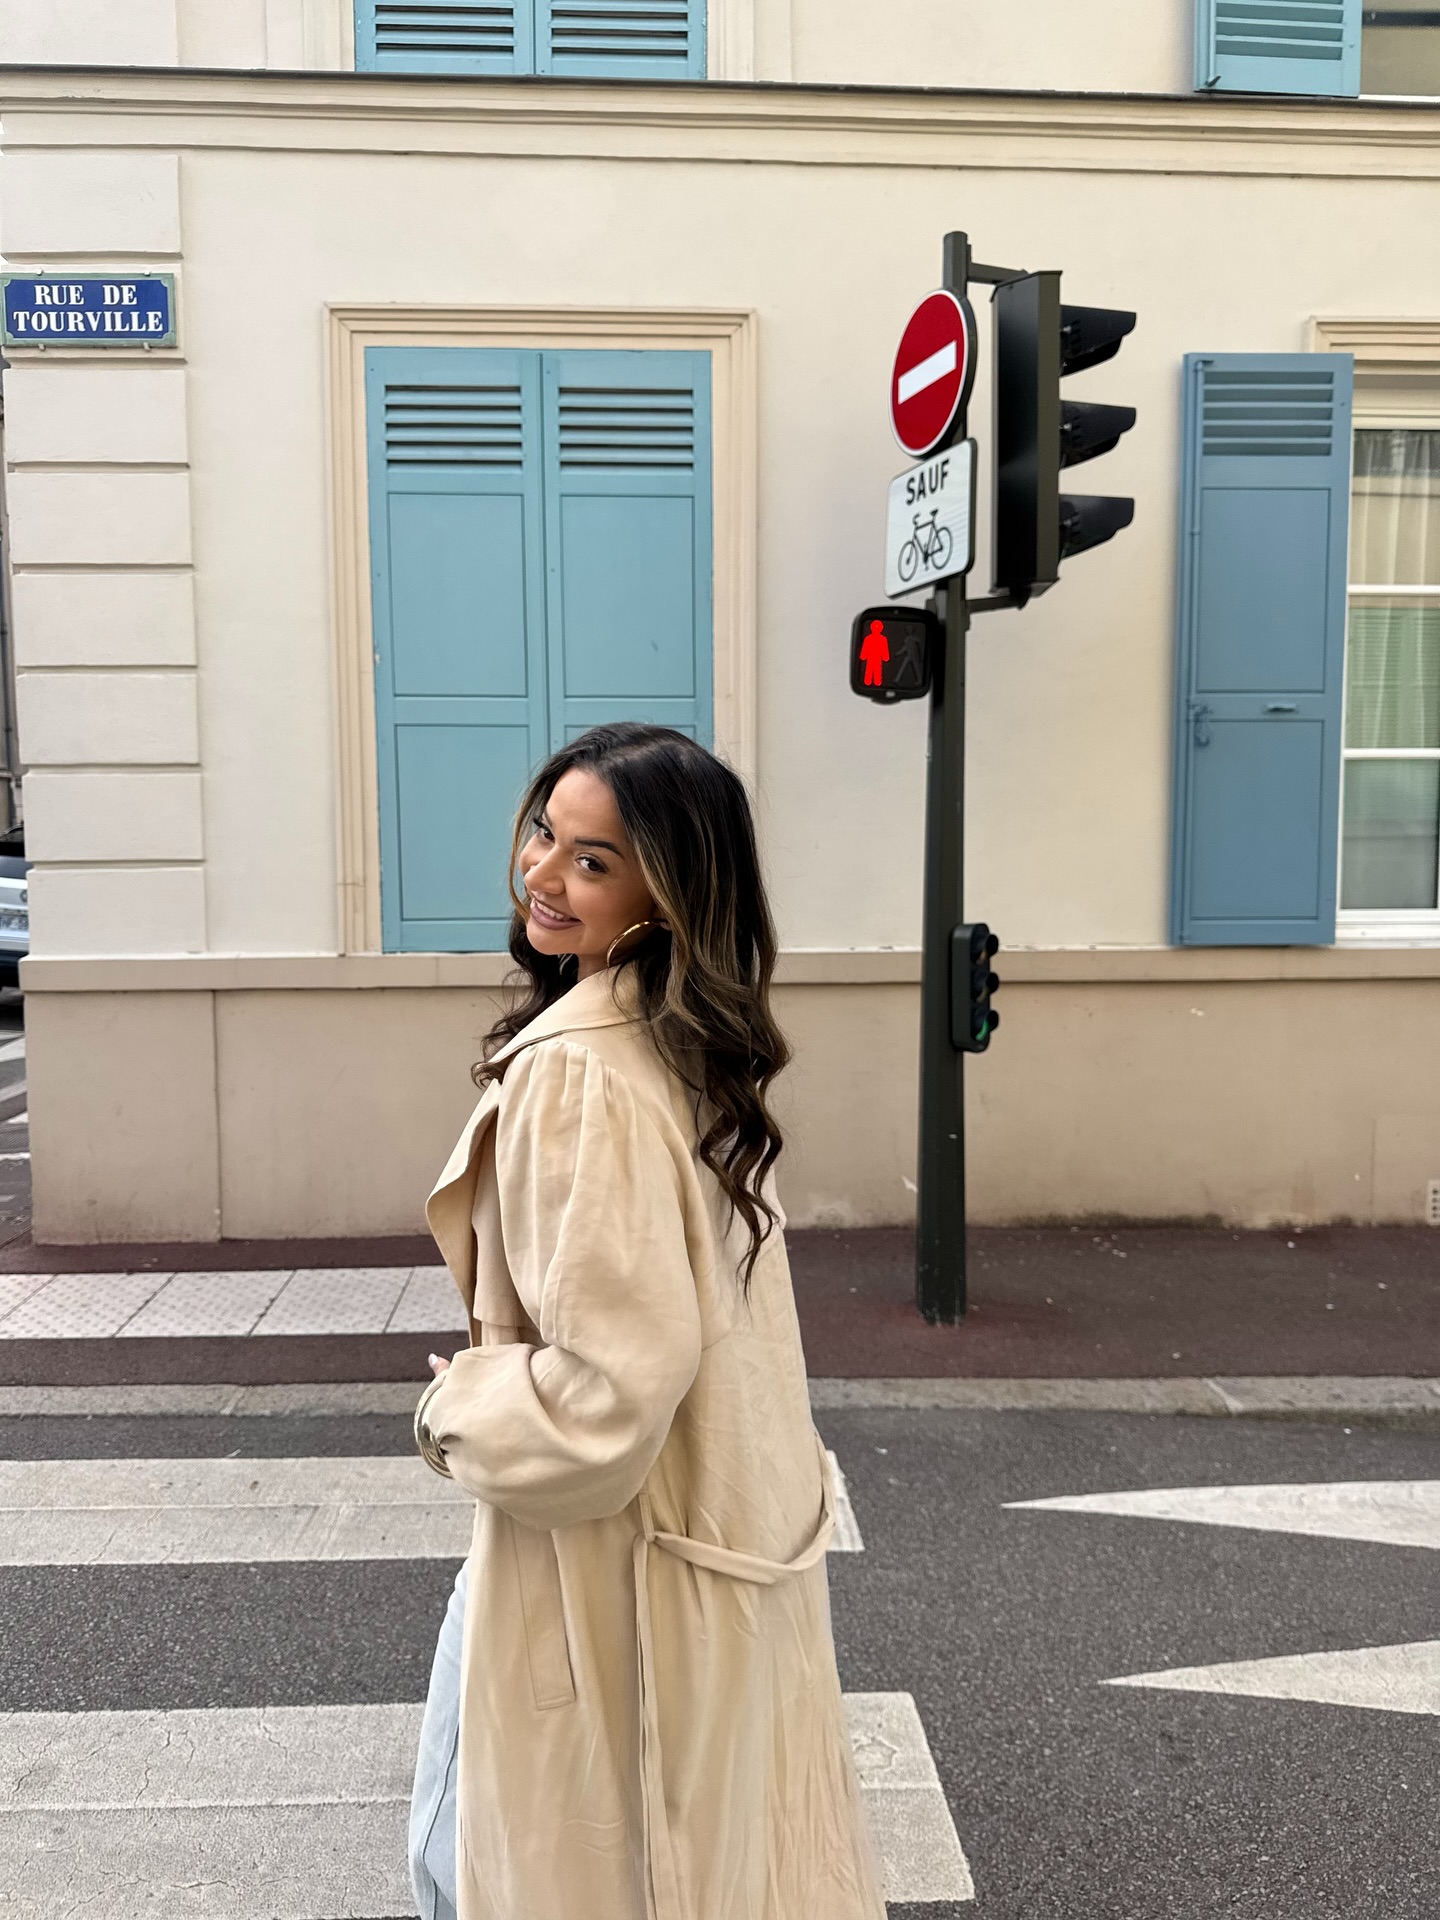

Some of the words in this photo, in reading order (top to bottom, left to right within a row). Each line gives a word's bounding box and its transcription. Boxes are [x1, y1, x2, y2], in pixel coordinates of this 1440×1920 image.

[34, 285, 84, 305] RUE
[102, 285, 137, 305] DE
[13, 311, 163, 332] TOURVILLE
[906, 458, 949, 506] SAUF
